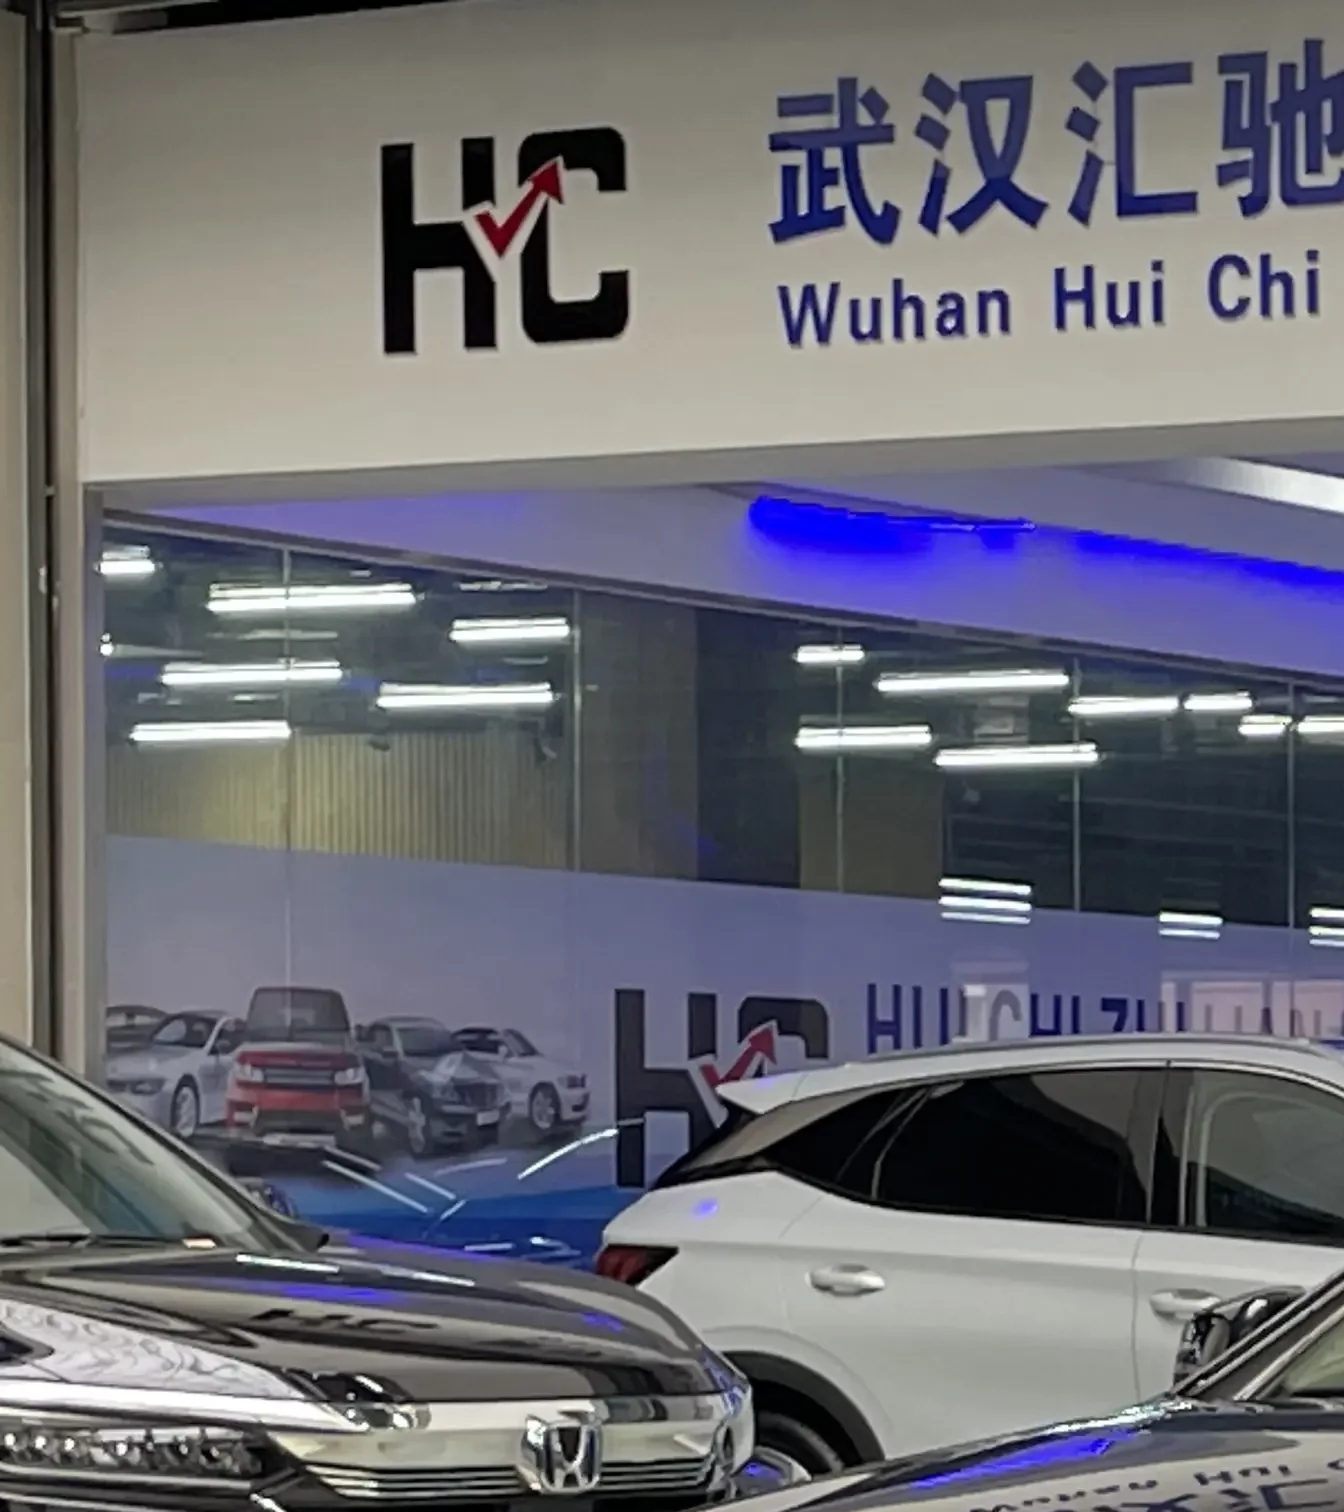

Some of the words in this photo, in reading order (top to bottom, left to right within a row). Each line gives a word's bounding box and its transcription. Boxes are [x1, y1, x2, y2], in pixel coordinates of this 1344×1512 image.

[379, 125, 630, 355] HC
[778, 281, 1011, 347] Wuhan
[1052, 263, 1165, 327] Hui
[1207, 251, 1320, 319] Chi
